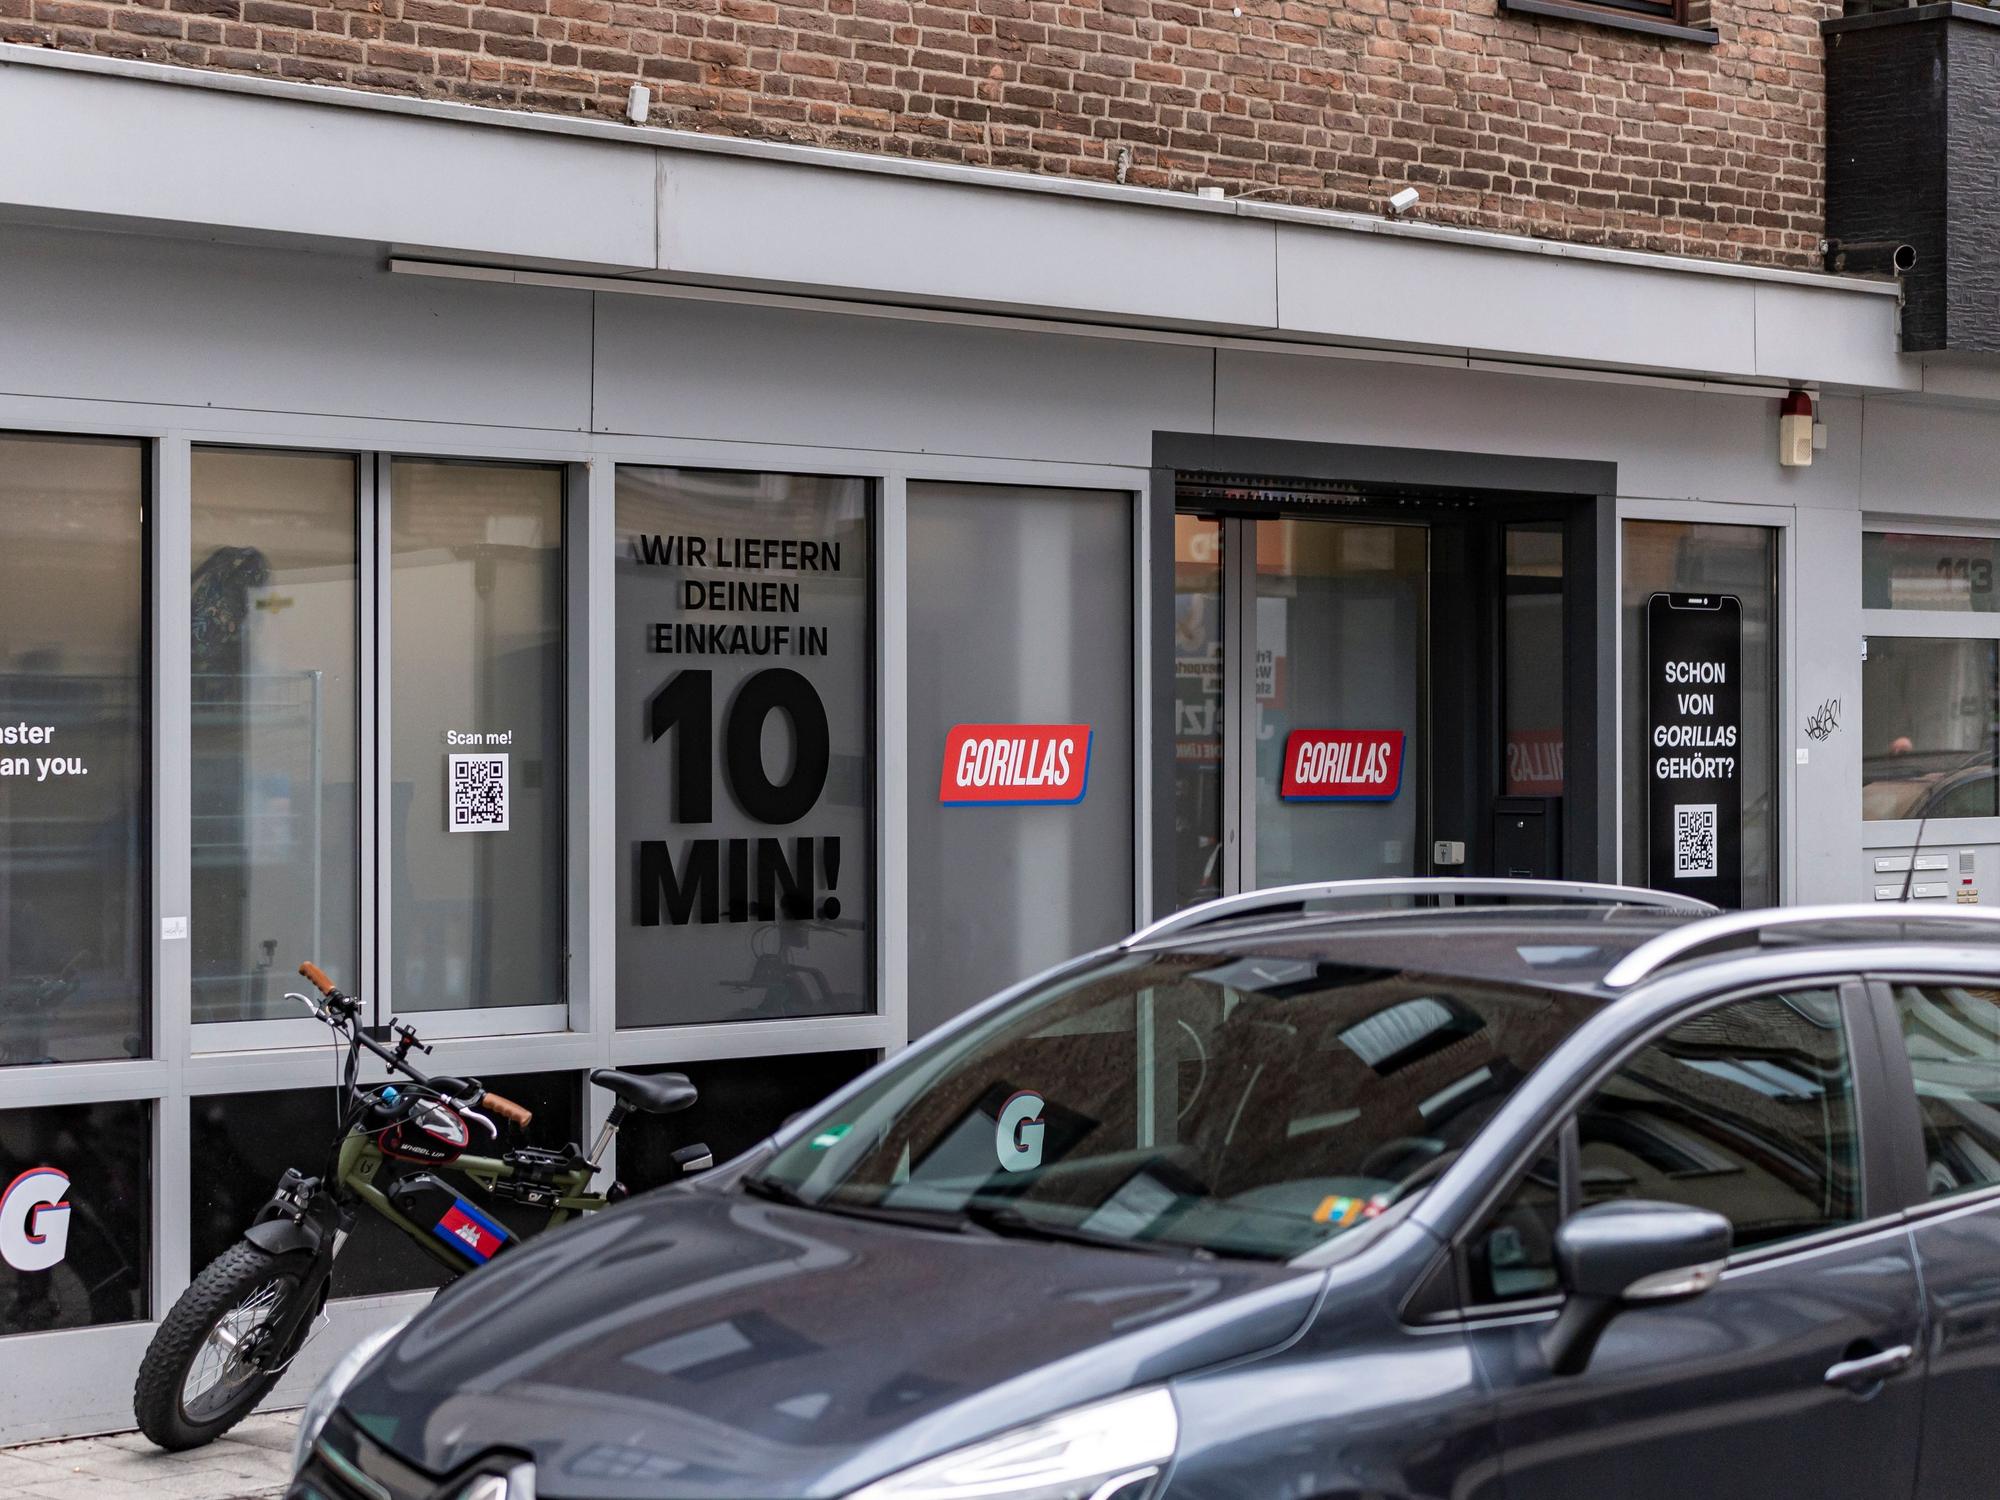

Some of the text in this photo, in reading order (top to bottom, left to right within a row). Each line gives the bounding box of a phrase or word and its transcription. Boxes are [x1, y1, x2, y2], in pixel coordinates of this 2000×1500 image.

[641, 534, 840, 571] WIR LIEFERN
[1936, 557, 1993, 593] 113
[685, 580, 799, 612] DEINEN
[655, 623, 828, 656] EINKAUF IN
[1665, 661, 1726, 683] SCHON
[1677, 693, 1714, 715] VON
[447, 730, 512, 745] Scan me!
[651, 667, 830, 825] 10
[1654, 725, 1737, 747] GORILLAS
[36, 757, 88, 782] you.
[956, 738, 1074, 786] GORILLAS
[1295, 741, 1391, 784] GORILLAS
[1656, 752, 1735, 779] GEHÖRT?
[639, 836, 841, 927] MIN!
[996, 1088, 1045, 1173] G
[0, 1166, 71, 1272] G
